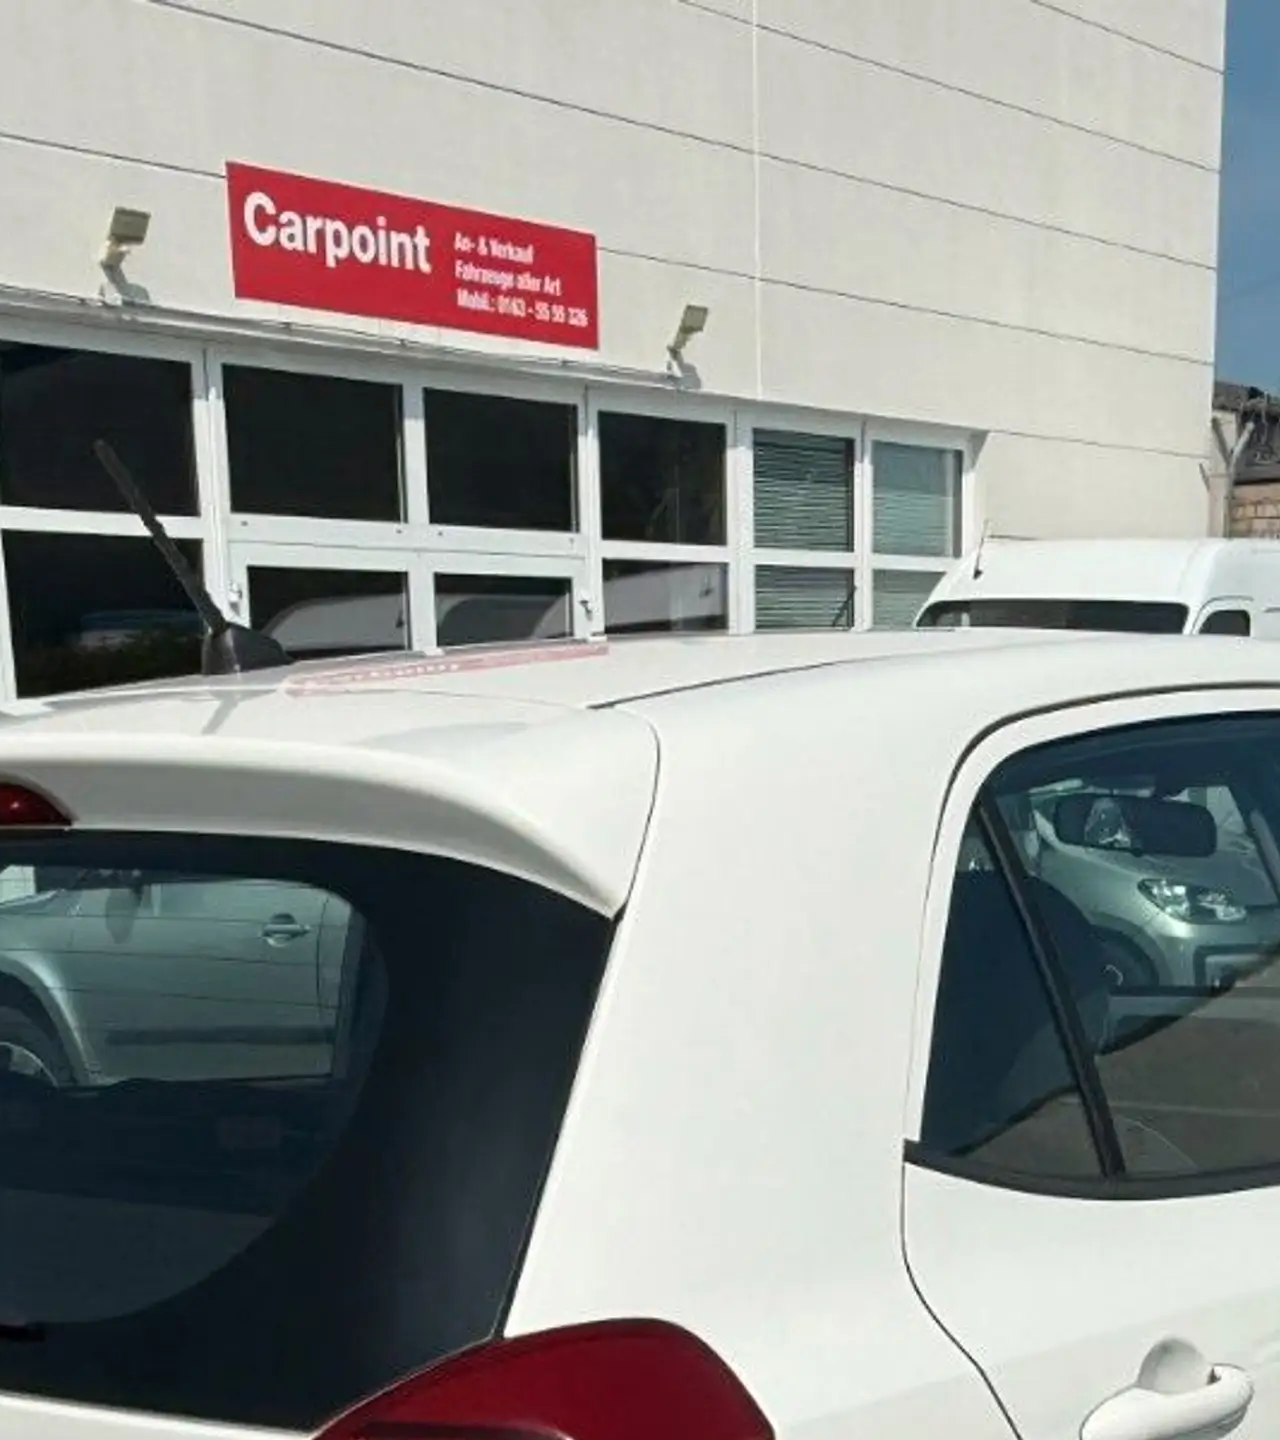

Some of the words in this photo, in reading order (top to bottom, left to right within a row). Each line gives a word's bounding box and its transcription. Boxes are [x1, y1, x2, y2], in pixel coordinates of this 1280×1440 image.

[243, 191, 432, 274] Carpoint
[454, 232, 475, 253] An-
[477, 235, 488, 256] &
[489, 238, 534, 265] Verkauf
[455, 259, 514, 292] Fahrzeuge
[516, 271, 541, 292] aller
[543, 275, 561, 296] Art
